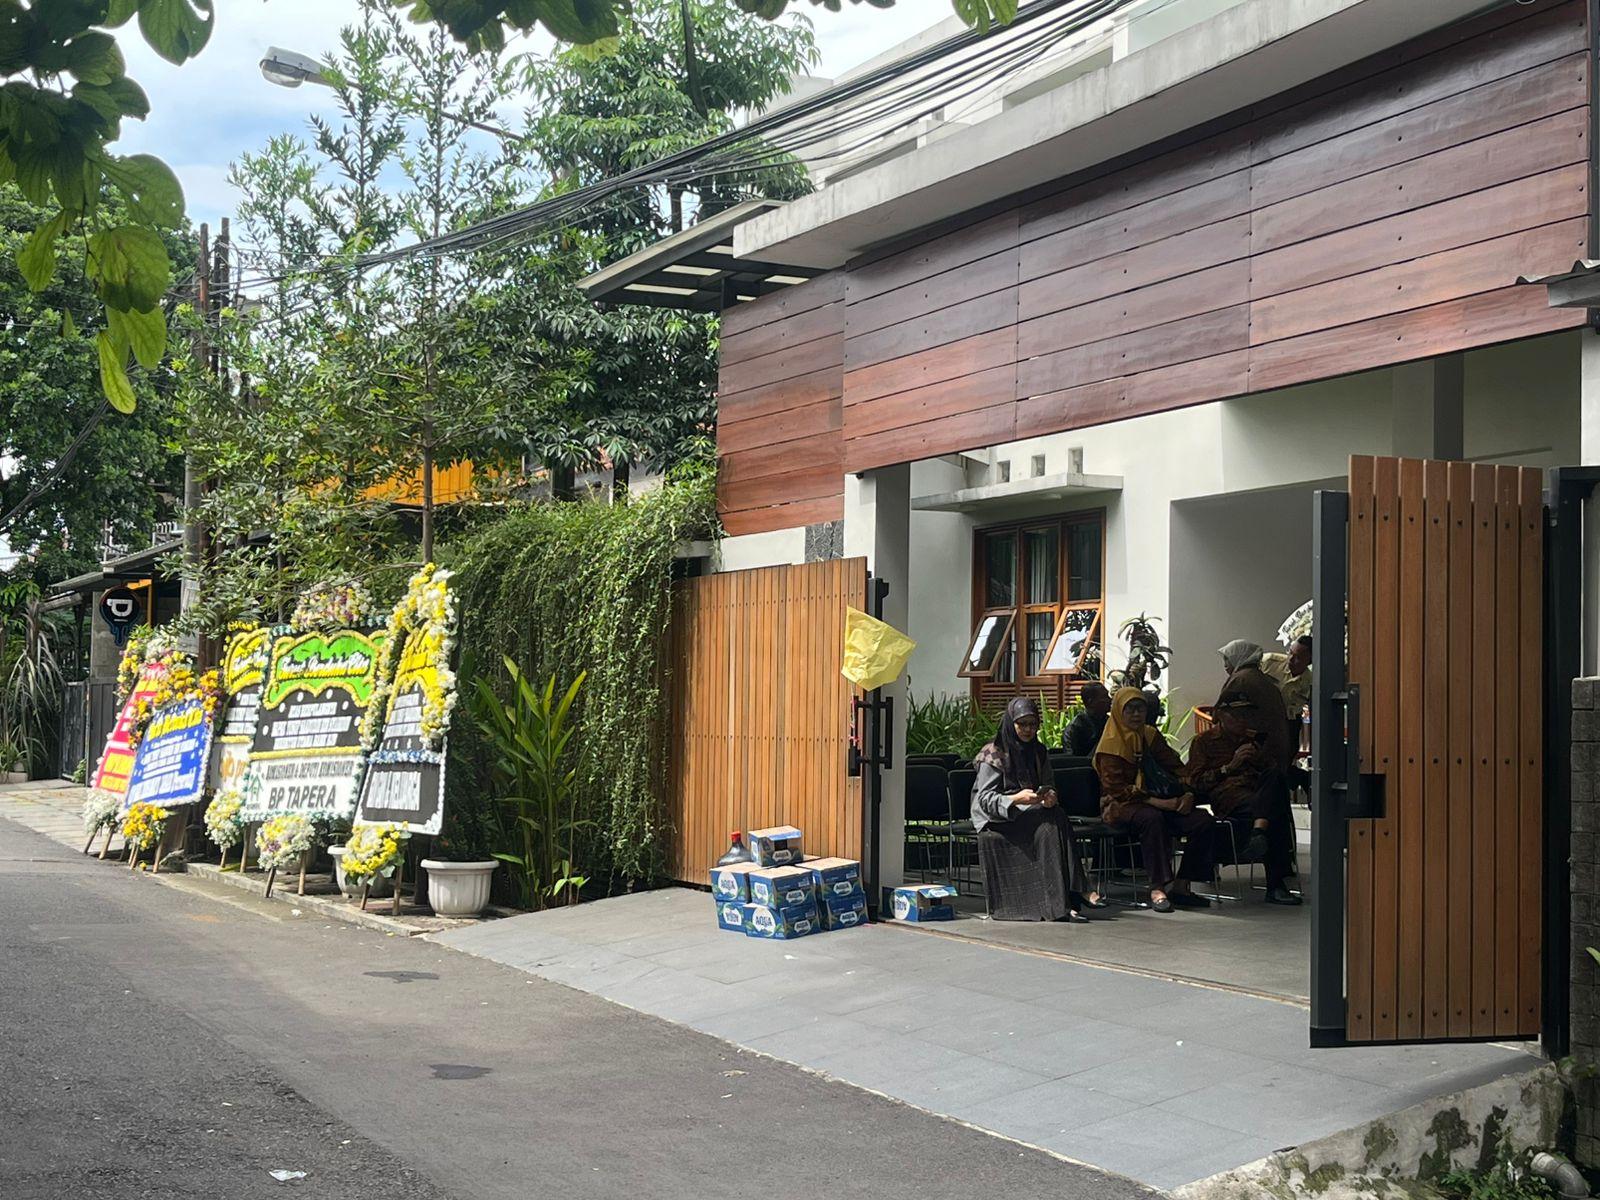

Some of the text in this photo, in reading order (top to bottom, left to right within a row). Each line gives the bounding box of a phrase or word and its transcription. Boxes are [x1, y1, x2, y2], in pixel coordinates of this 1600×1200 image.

[268, 784, 337, 809] BP TAPERA
[755, 915, 773, 928] AQUA
